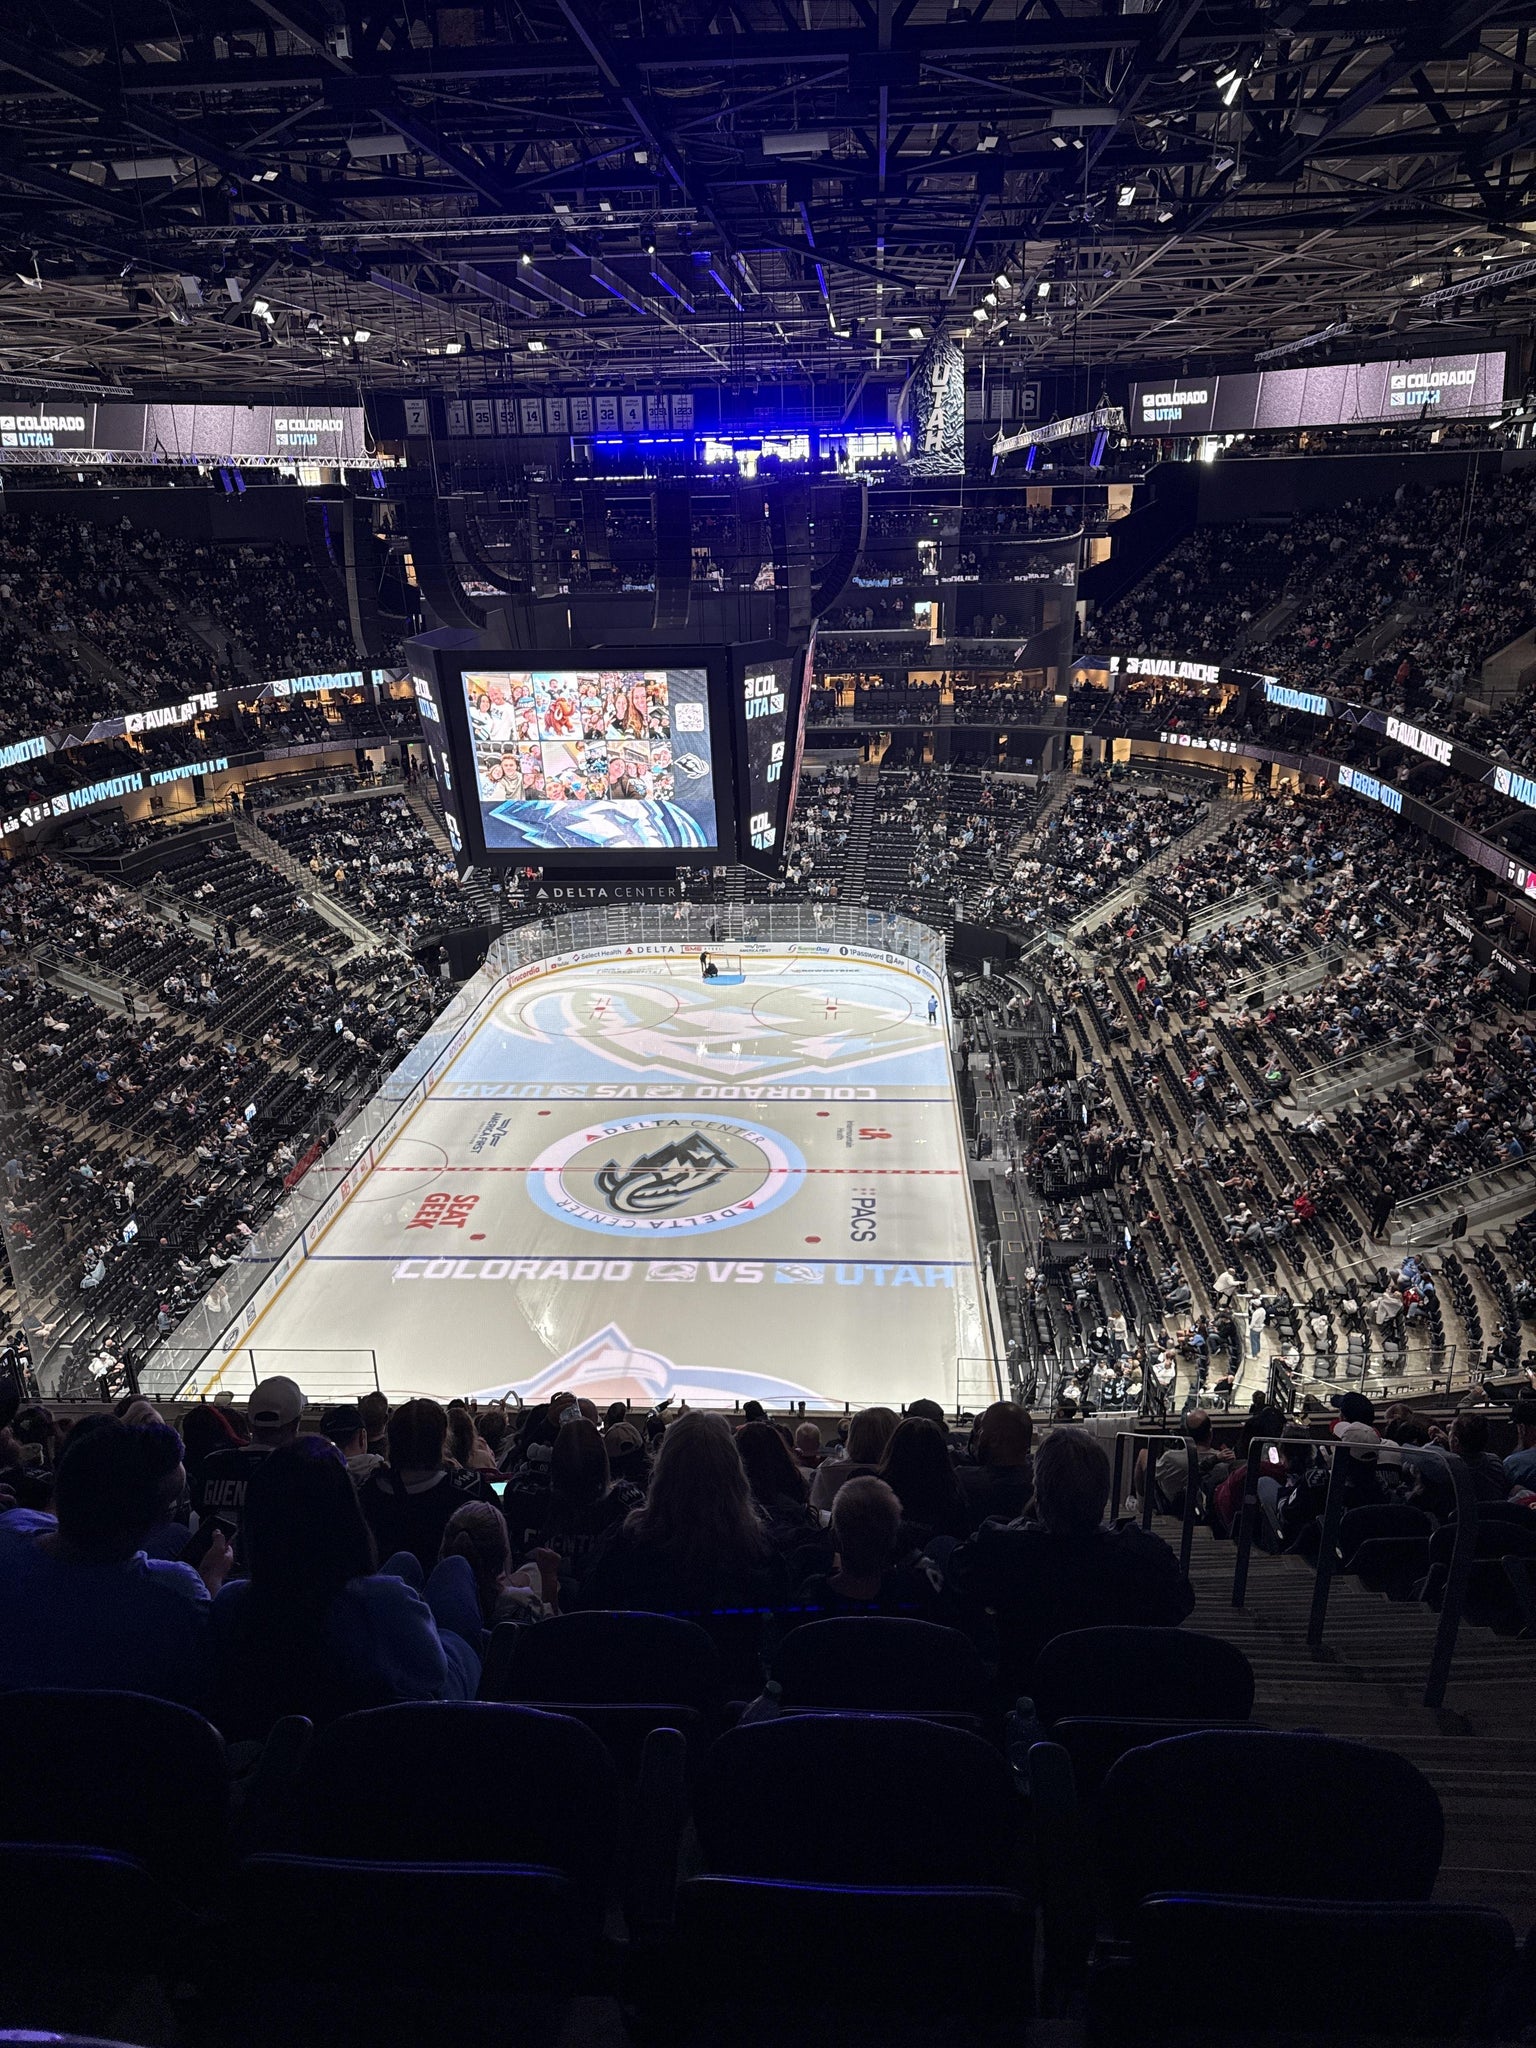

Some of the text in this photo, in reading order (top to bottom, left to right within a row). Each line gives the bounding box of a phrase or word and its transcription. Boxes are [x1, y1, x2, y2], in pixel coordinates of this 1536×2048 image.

[1406, 370, 1476, 388] COLORADO
[1022, 390, 1035, 410] 6
[1155, 390, 1207, 406] COLORADO
[1406, 390, 1440, 405] UTAH
[601, 409, 614, 420] 32
[629, 408, 636, 419] 4
[925, 363, 950, 451] UTAH
[1156, 408, 1182, 421] UTAH
[17, 416, 85, 431] COLORADO
[289, 419, 343, 431] COLORADO
[19, 433, 54, 446] UTAH
[290, 434, 317, 445] UTAH
[754, 674, 779, 697] COL
[745, 697, 769, 720] UTA
[1266, 684, 1327, 716] MAMMOTH
[1400, 722, 1453, 766] AVALANCHE
[68, 772, 144, 811] MAMMOTH
[553, 887, 676, 898] DELTA CENTER
[581, 948, 622, 960] Select Health
[637, 945, 675, 954] DELTA
[850, 948, 884, 960] 1Password
[603, 1119, 766, 1144] DELTA CENTER
[405, 1192, 451, 1230] GEEK
[438, 1194, 480, 1228] SEAT
[556, 1199, 738, 1229] DELTA CENTER
[850, 1197, 877, 1242] PACS
[393, 1258, 955, 1289] COLORADO VS UTAH
